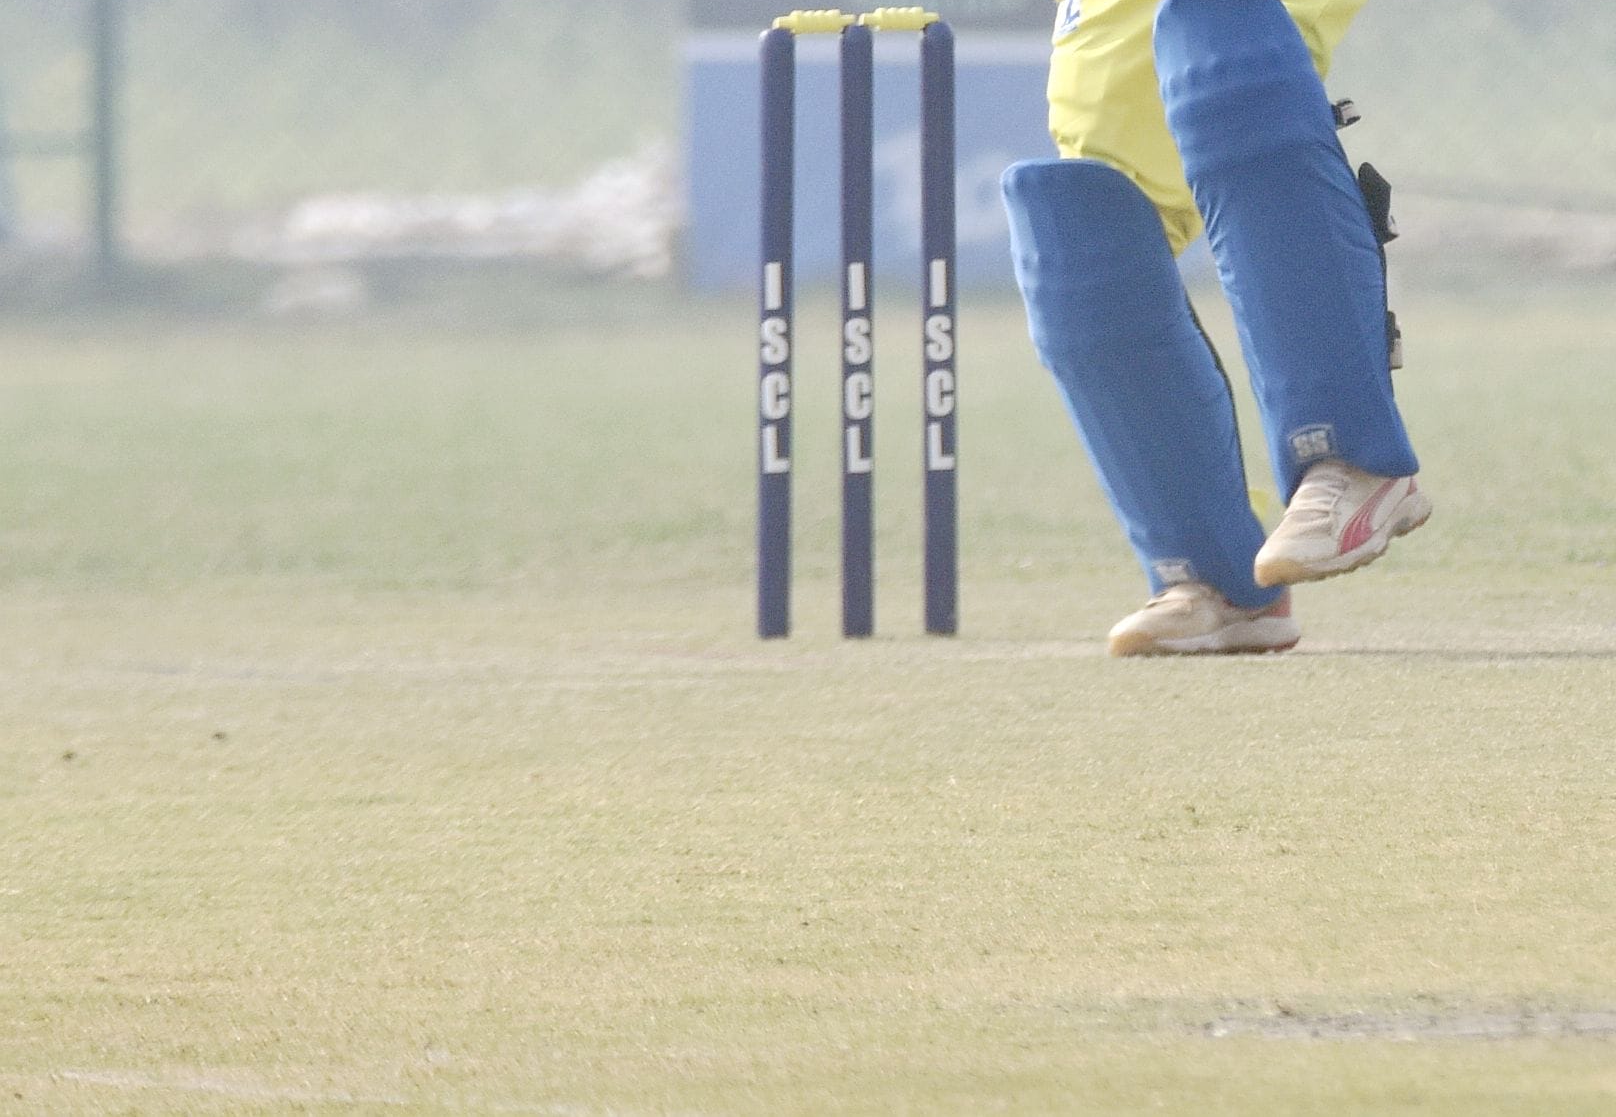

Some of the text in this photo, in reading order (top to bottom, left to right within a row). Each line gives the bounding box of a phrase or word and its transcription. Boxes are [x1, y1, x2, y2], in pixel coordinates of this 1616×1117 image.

[761, 261, 790, 474] ISCL
[845, 261, 872, 474] ISCL
[926, 259, 955, 471] ISCL
